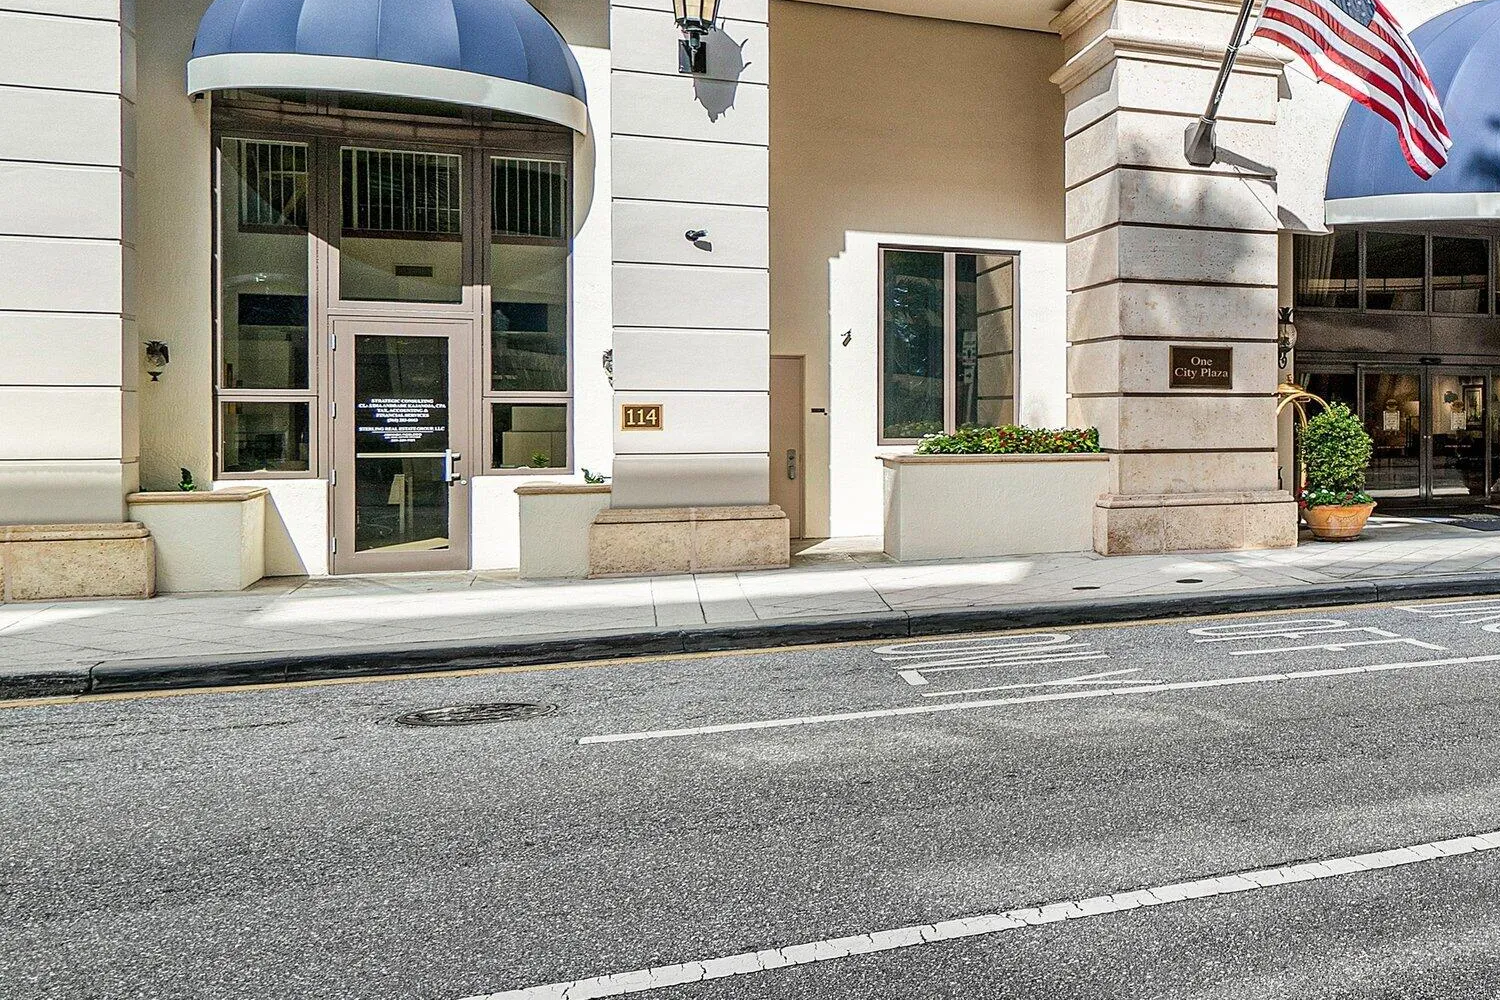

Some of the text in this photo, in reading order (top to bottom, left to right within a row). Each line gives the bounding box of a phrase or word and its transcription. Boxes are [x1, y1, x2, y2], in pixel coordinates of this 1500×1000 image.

[1191, 356, 1213, 366] One
[1174, 367, 1229, 379] City Plaza
[626, 409, 657, 425] 114
[1187, 619, 1449, 656] OFF
[872, 634, 1163, 697] ONLY
